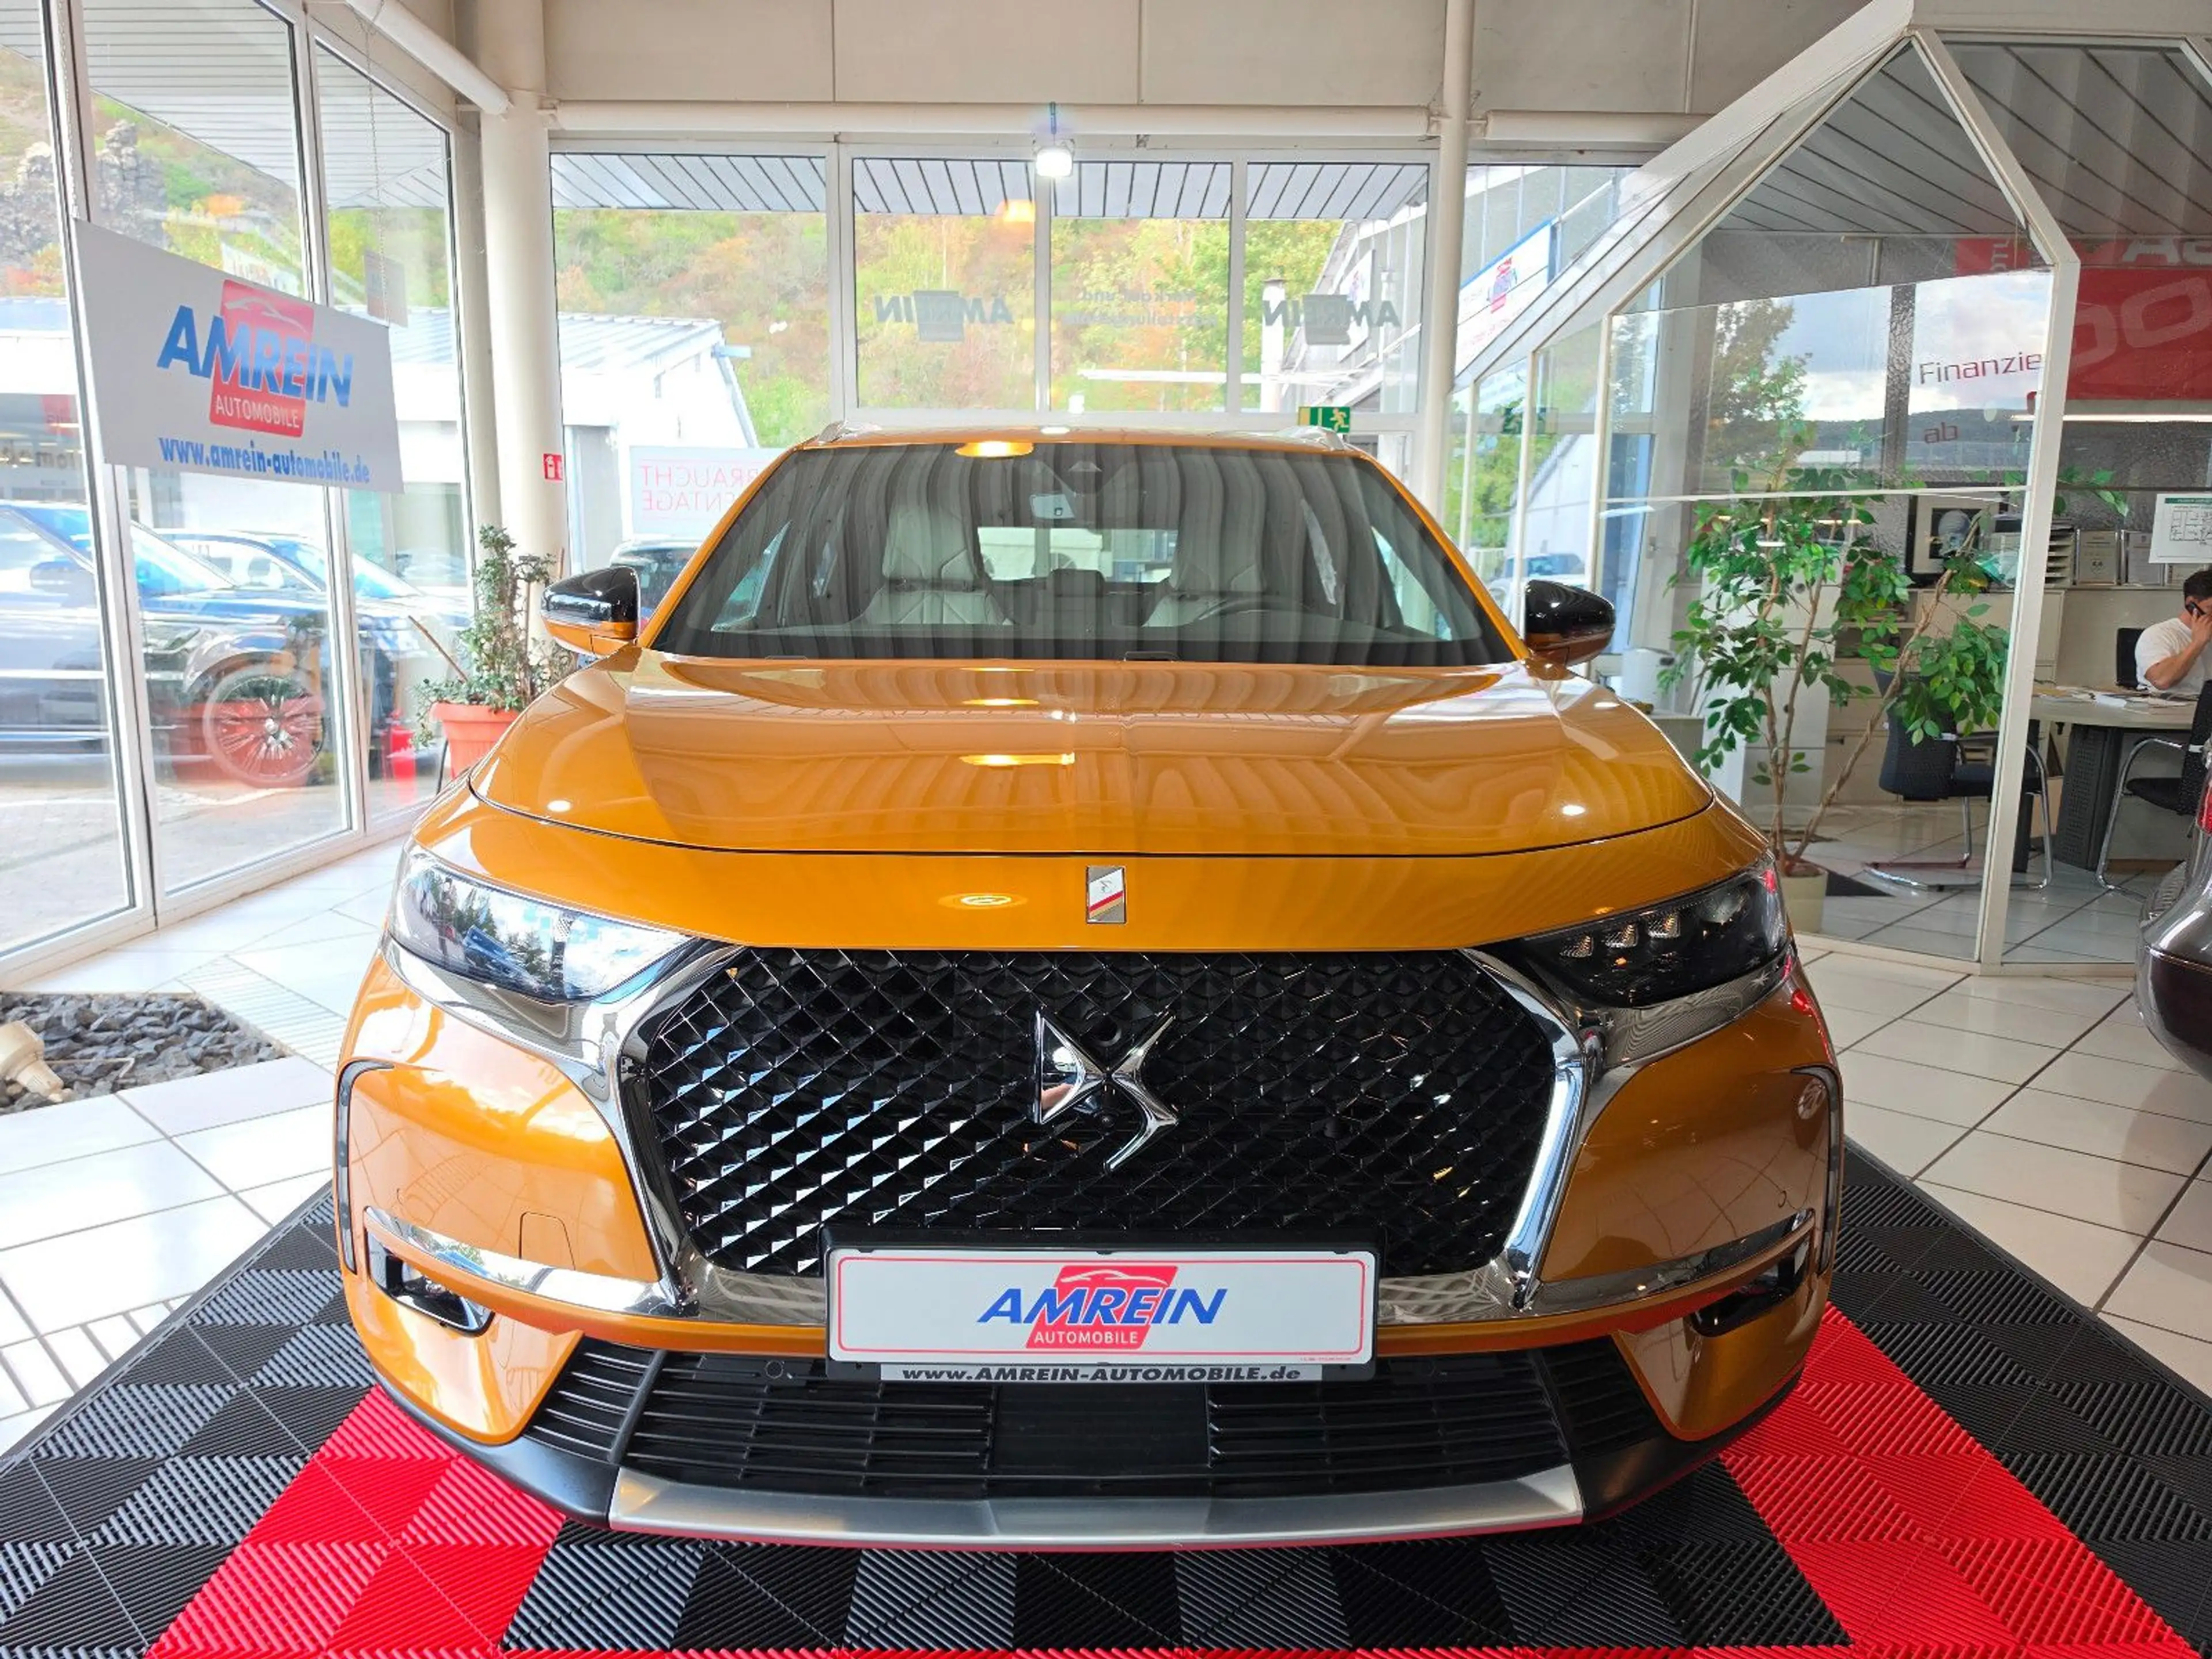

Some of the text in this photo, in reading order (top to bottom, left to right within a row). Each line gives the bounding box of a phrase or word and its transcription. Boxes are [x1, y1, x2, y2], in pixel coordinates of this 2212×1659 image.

[156, 305, 354, 407] AMREIN
[215, 394, 301, 429] AUTOMOBILE
[1924, 422, 1958, 444] ab
[157, 437, 370, 483] www.amrein-automobile.de
[976, 1288, 1228, 1324] AMREIN
[1034, 1331, 1139, 1344] AUTOMOBILE
[902, 1366, 1302, 1382] www.AMREIN-AUTOMOBILE.de
